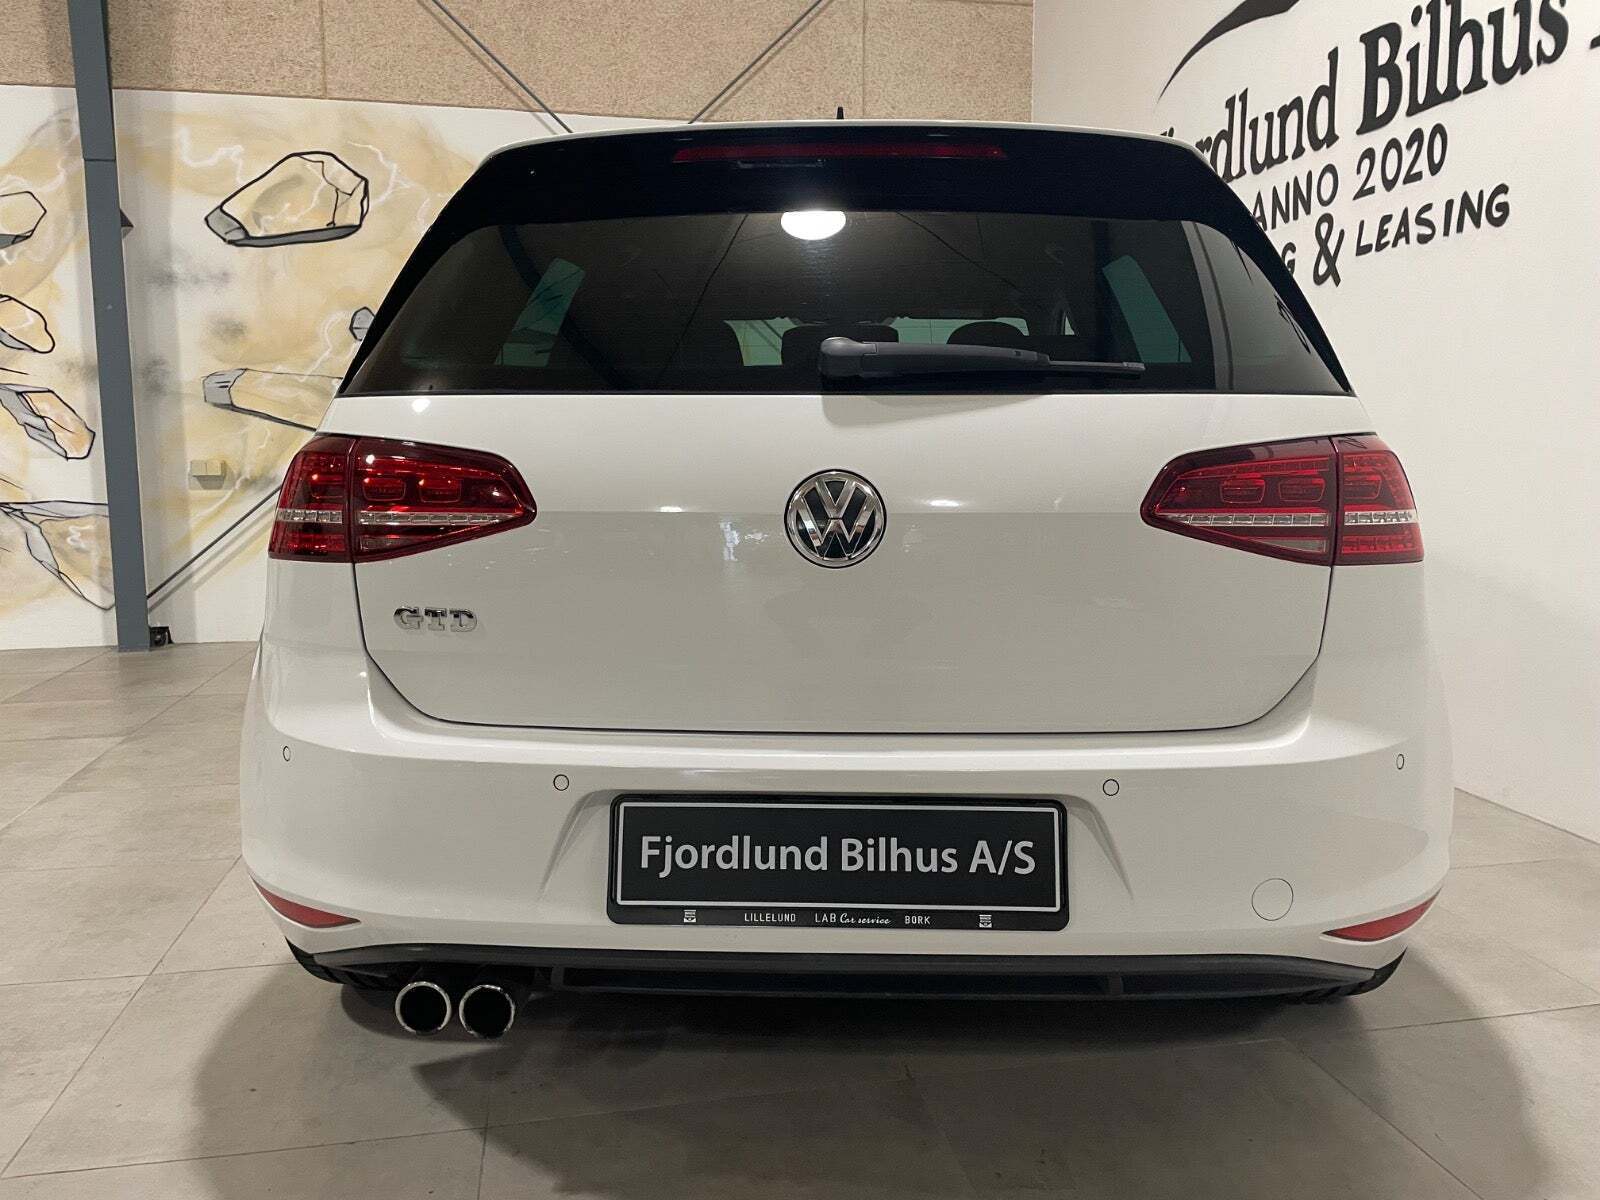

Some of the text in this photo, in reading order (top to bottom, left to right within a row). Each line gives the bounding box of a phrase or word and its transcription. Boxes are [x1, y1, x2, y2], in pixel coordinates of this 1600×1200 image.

[1356, 0, 1569, 135] Bilhus
[1252, 122, 1448, 233] ANNO 2020
[1312, 212, 1345, 287] &
[1355, 183, 1510, 257] LEASING
[393, 606, 478, 633] GTD
[640, 835, 1037, 878] Fjordlund Bilhus A/S
[744, 912, 931, 925] LILLELUND LAB Car service BORK
